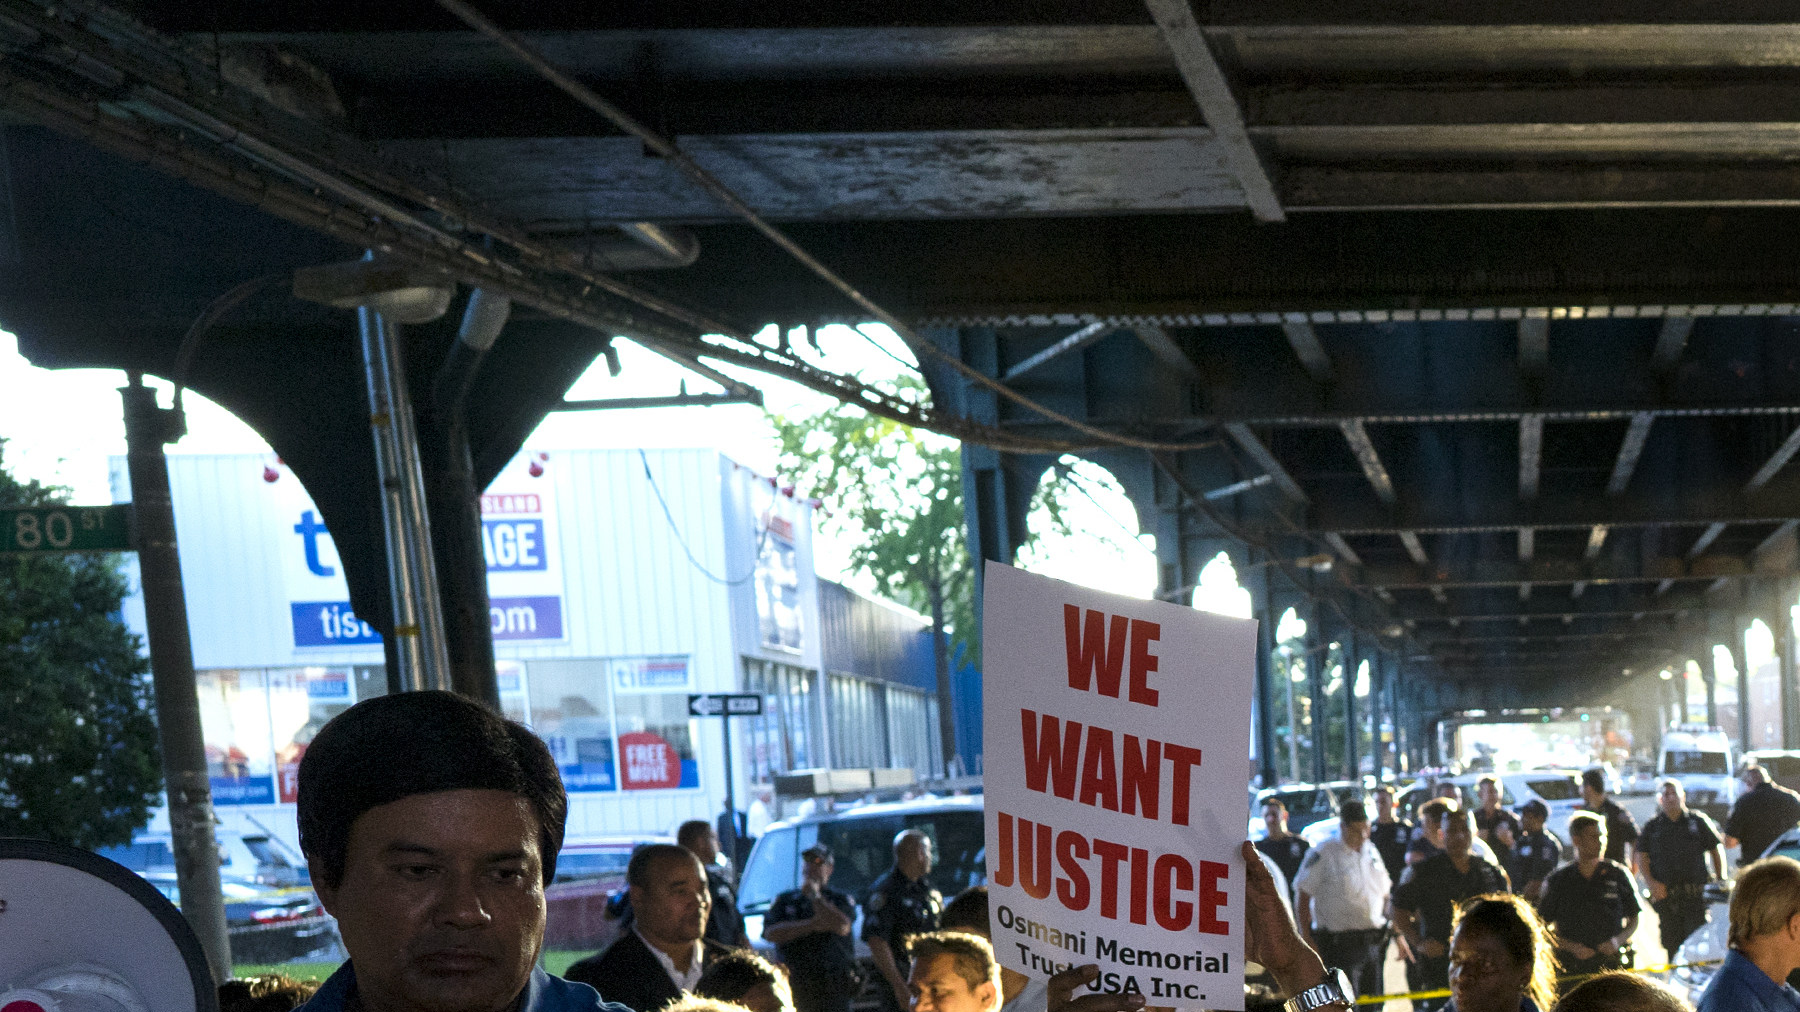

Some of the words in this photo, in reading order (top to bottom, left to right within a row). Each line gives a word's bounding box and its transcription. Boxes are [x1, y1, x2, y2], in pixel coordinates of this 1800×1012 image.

[15, 511, 73, 548] 80
[81, 508, 105, 530] ST
[1064, 603, 1160, 707] WE
[625, 744, 667, 762] FREE
[627, 762, 668, 783] MOVE
[1021, 708, 1202, 826] WANT
[994, 811, 1229, 935] JUSTICE
[997, 905, 1086, 954] Osmani
[1096, 936, 1229, 973] Memorial
[1150, 977, 1206, 1000] Inc.
